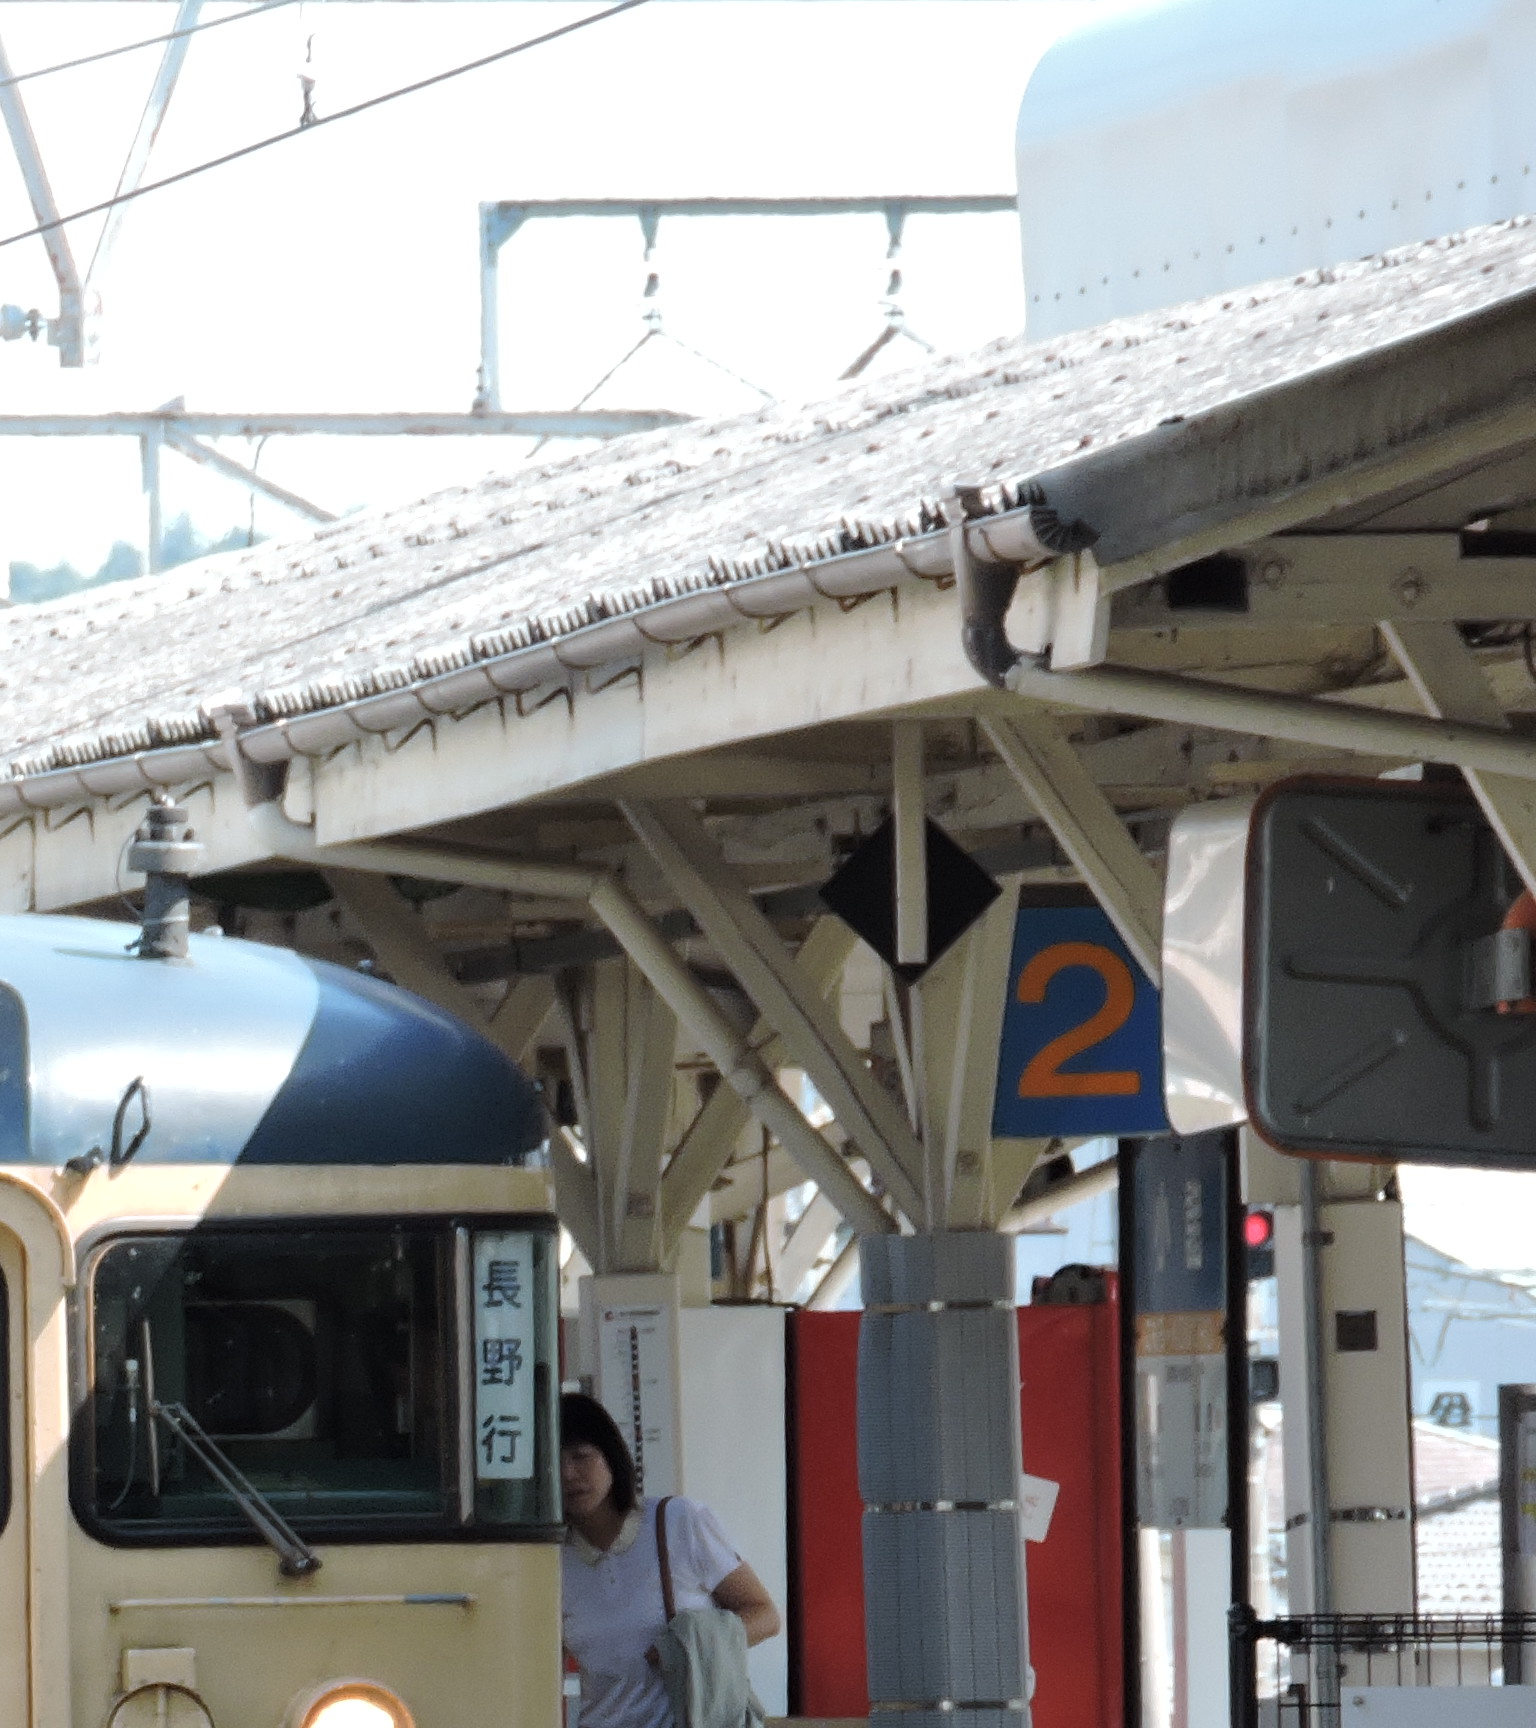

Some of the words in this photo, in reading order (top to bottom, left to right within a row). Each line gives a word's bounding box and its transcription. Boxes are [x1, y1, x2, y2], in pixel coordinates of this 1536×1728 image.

[1016, 941, 1141, 1098] 2
[481, 1260, 523, 1465] 長野行
